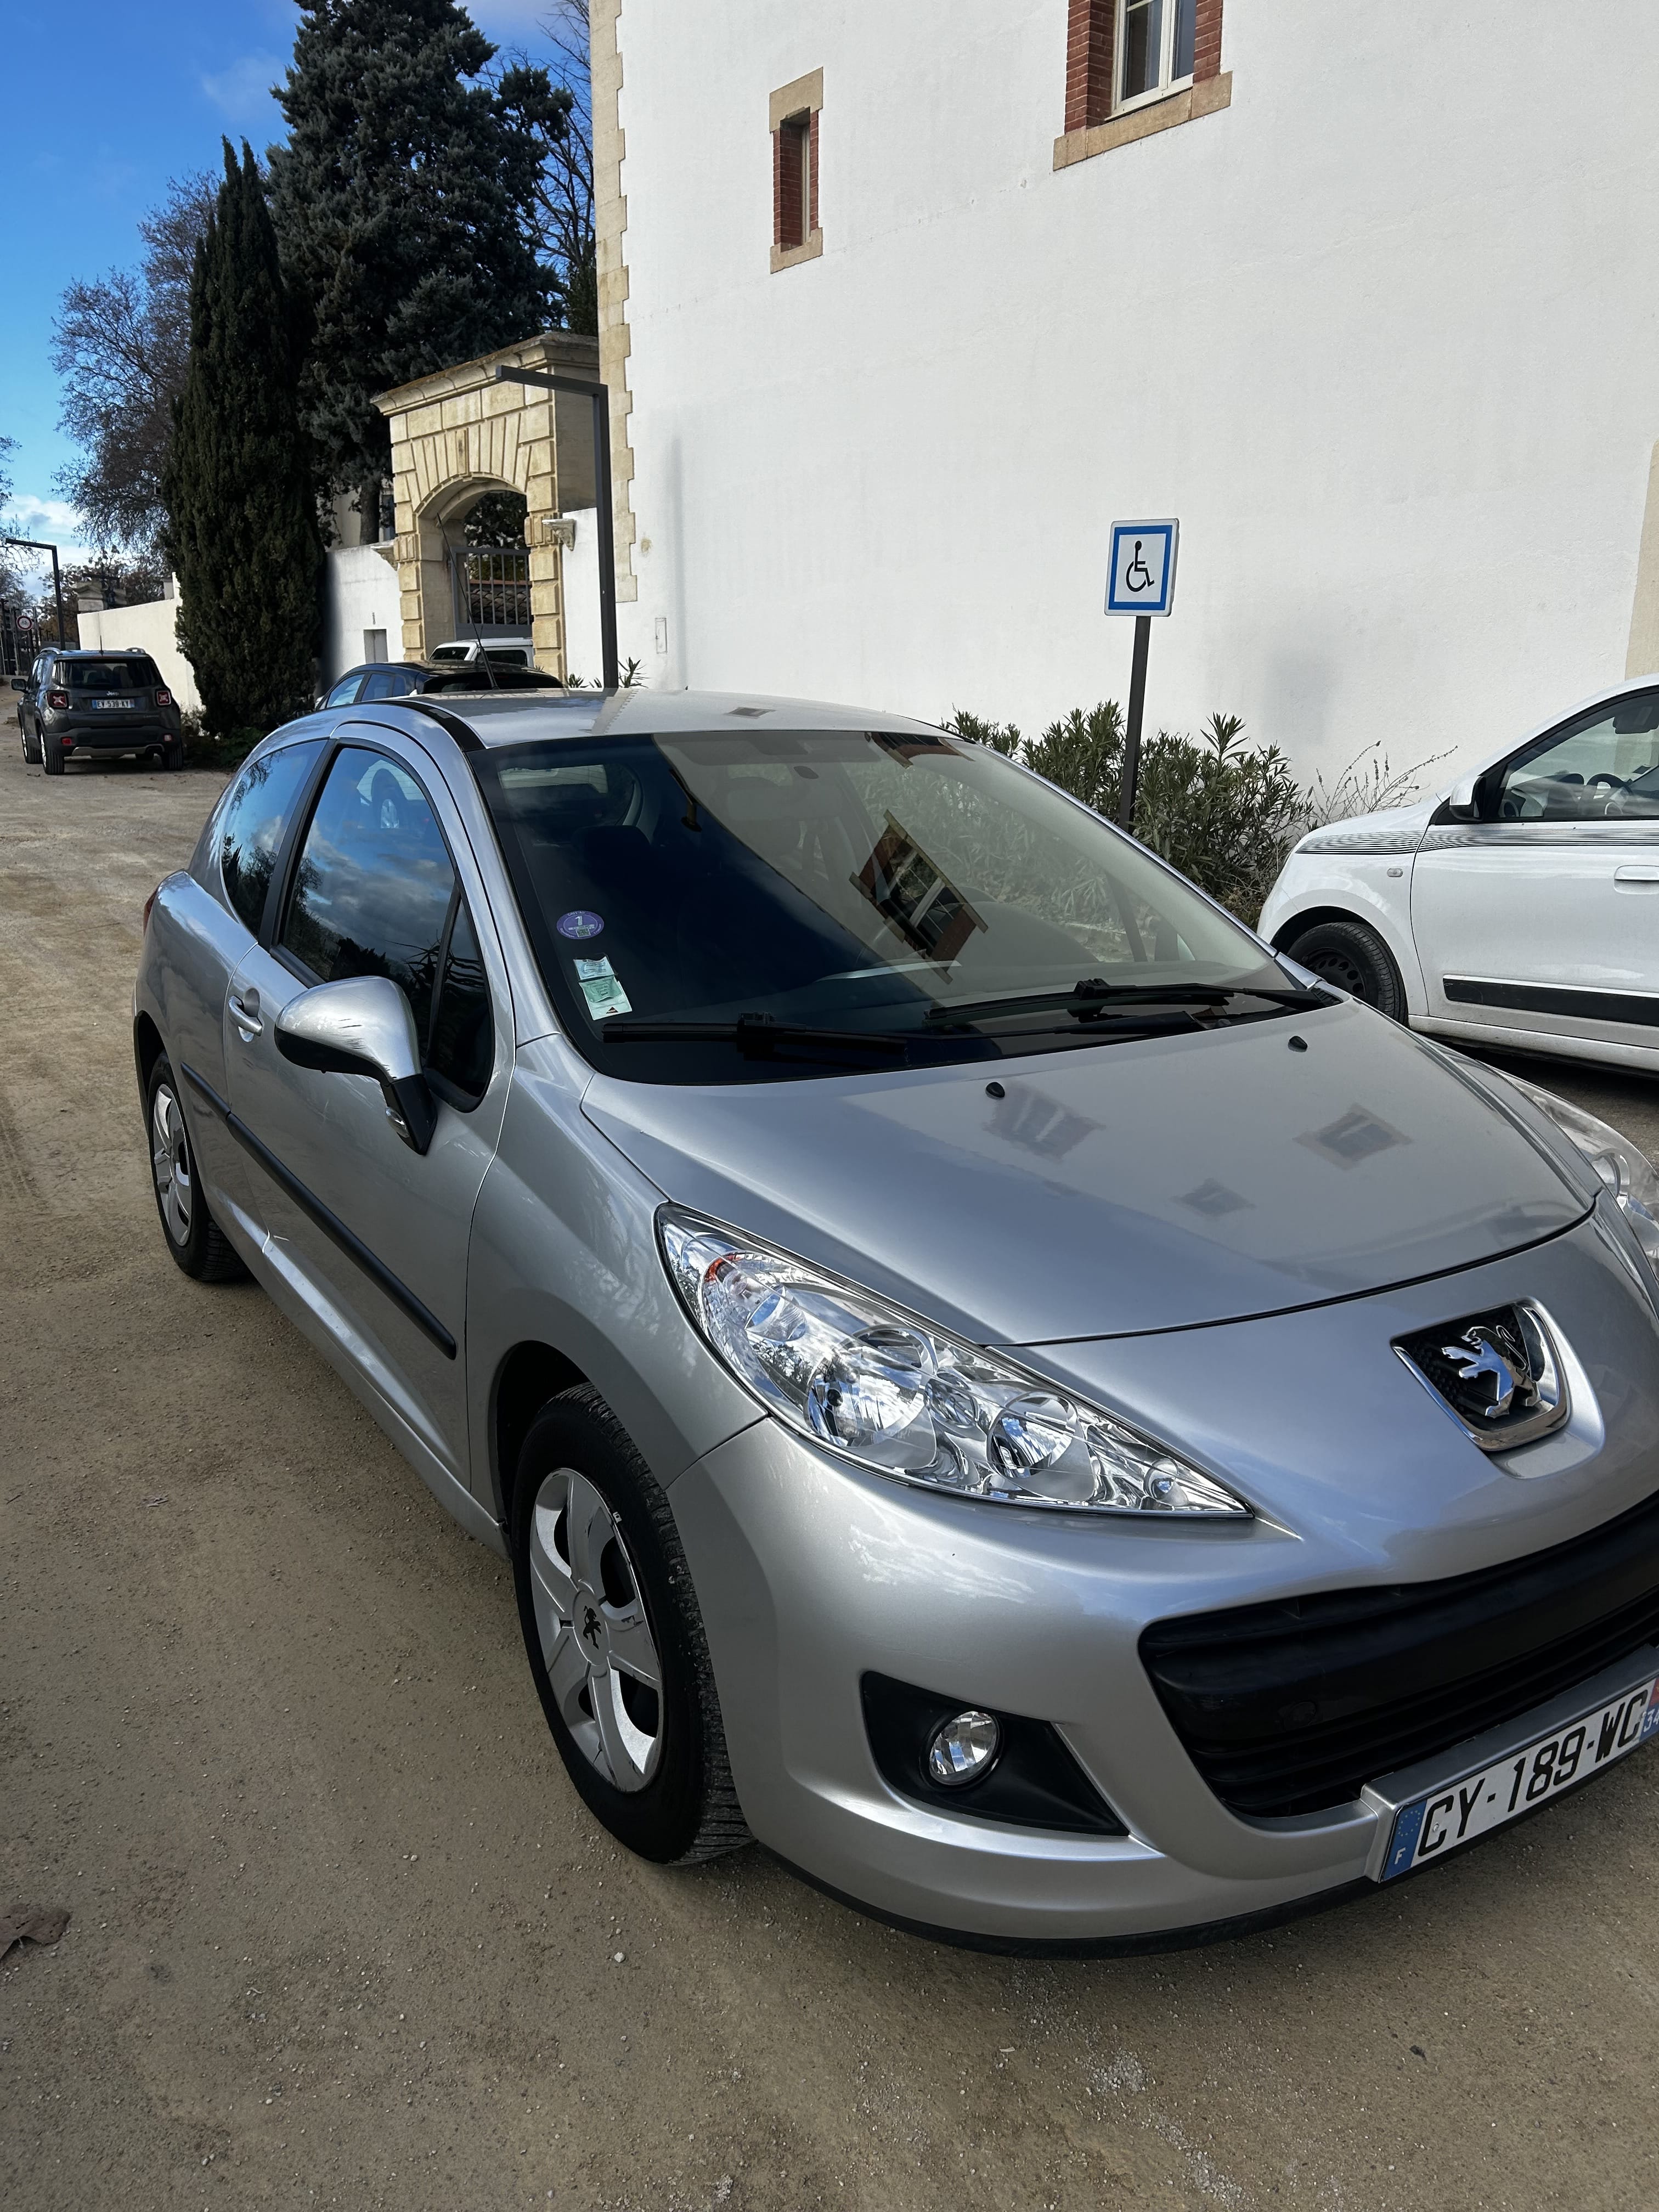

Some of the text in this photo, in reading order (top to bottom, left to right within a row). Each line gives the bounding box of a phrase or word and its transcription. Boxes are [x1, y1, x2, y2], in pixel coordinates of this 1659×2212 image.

[575, 916, 583, 926] 1
[1418, 1689, 1648, 1857] CY-189-WC
[1394, 1847, 1406, 1865] F
